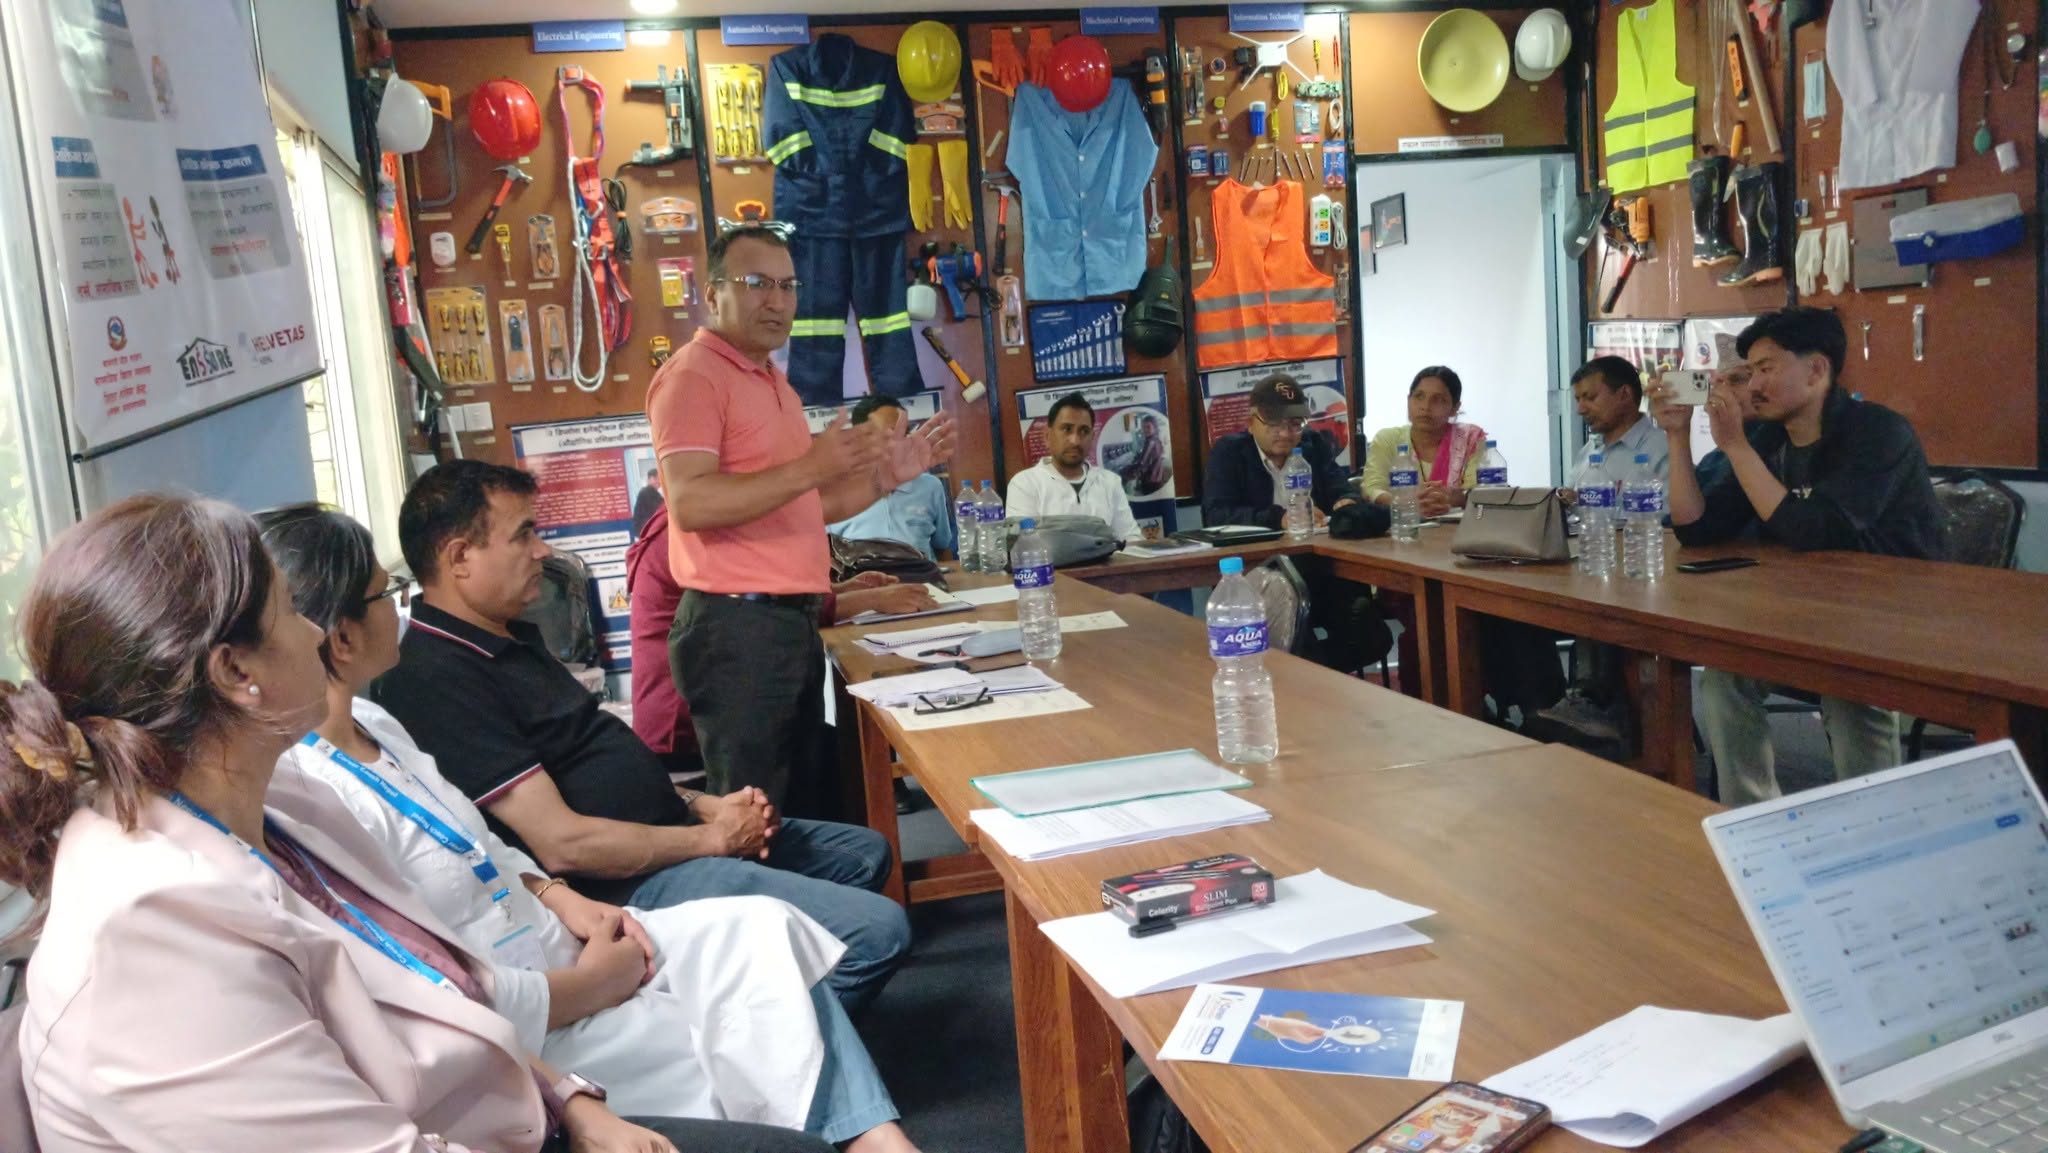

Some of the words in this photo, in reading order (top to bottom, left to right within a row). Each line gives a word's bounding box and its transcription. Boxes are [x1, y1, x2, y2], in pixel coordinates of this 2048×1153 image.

[727, 24, 764, 34] Automobile
[765, 24, 804, 35] Engineering
[537, 30, 574, 41] Electrical
[575, 30, 622, 43] Engineering
[252, 325, 304, 351] HELVETAS
[1224, 630, 1263, 644] AQUA
[1203, 889, 1228, 901] SLIM
[1148, 904, 1179, 918] Celerity
